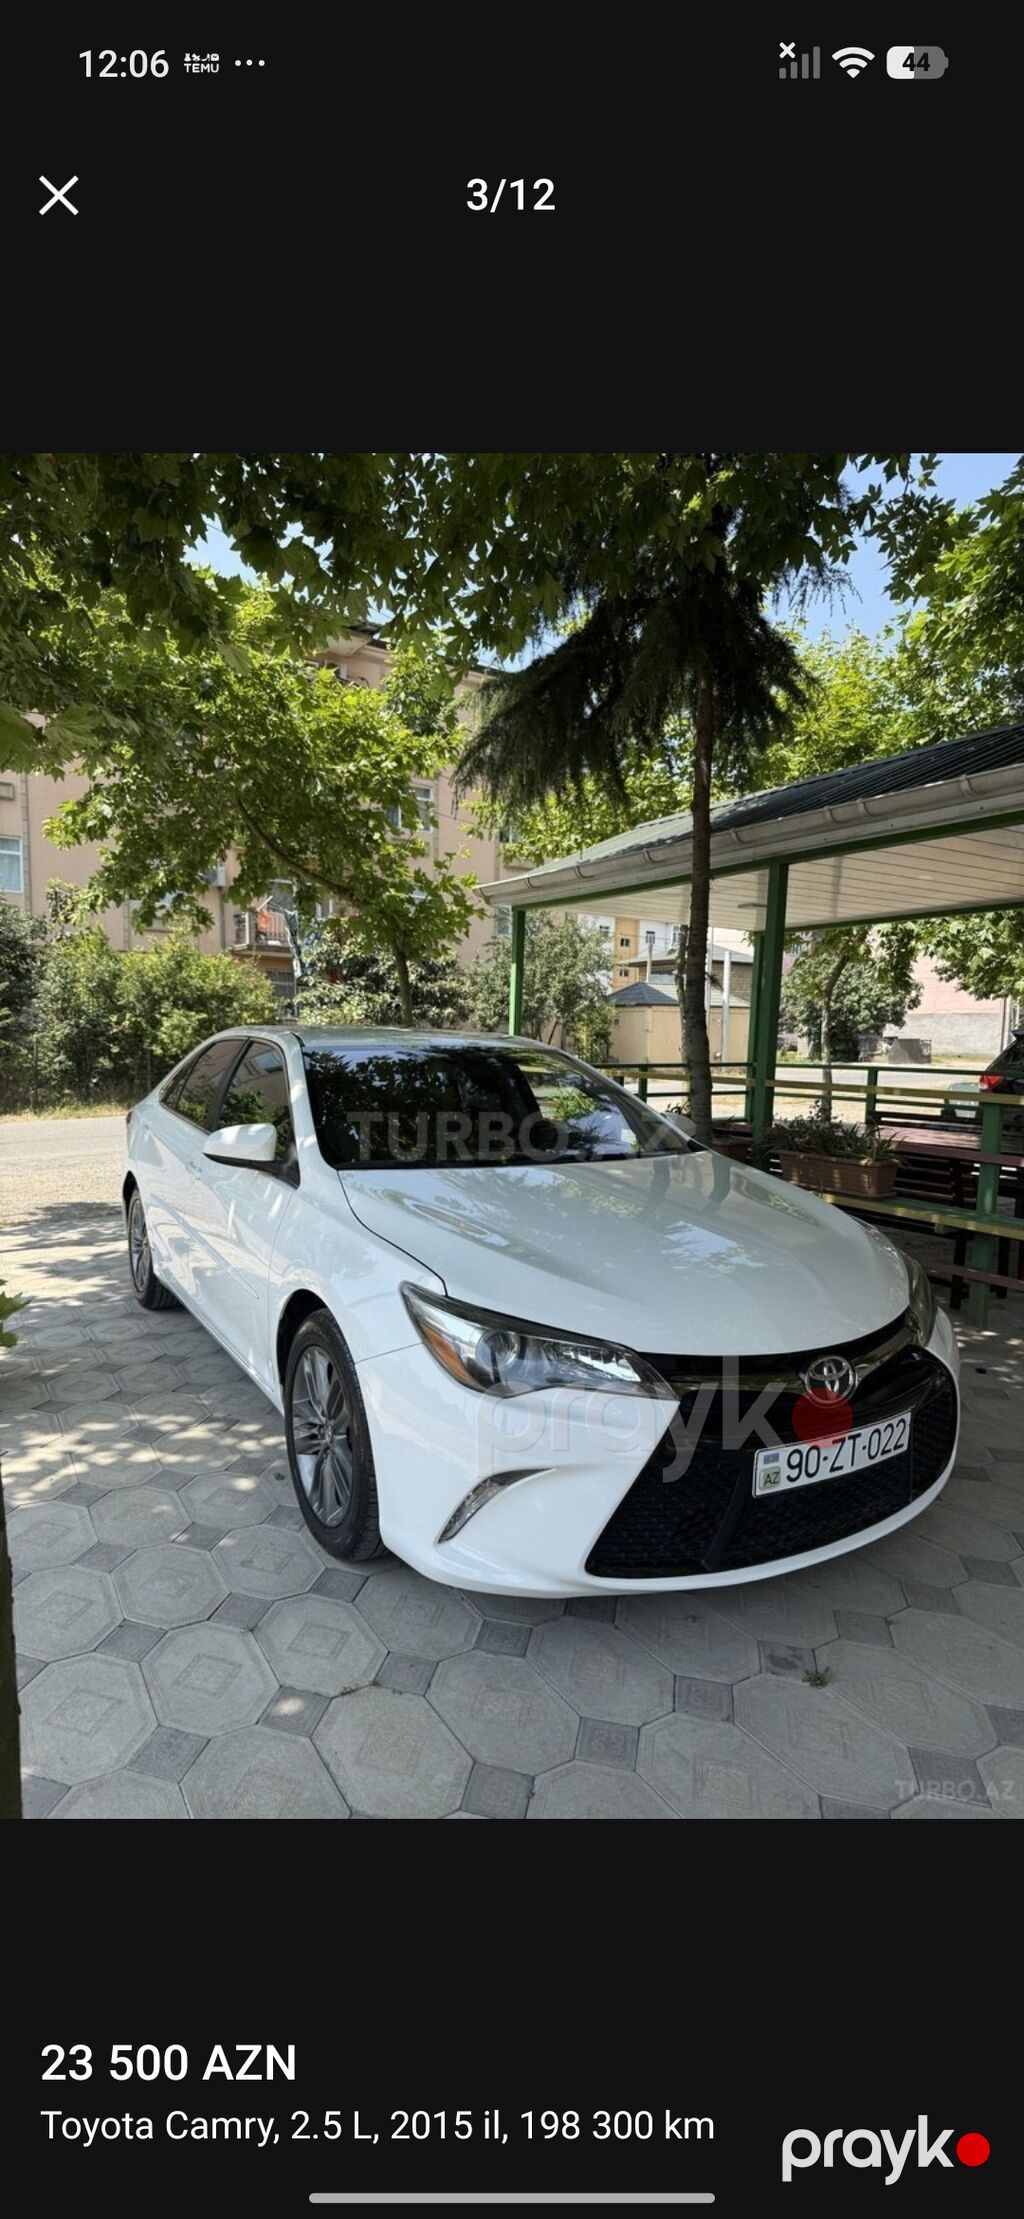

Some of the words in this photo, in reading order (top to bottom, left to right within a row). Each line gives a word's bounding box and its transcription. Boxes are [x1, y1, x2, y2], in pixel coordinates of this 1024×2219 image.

[79, 49, 170, 78] 12:06
[183, 62, 220, 74] TEMU
[902, 52, 931, 72] 44
[466, 177, 556, 214] 3/12
[763, 1470, 780, 1487] AZ
[41, 2043, 93, 2081] 23
[109, 2043, 189, 2081] 500
[201, 2044, 297, 2081] AZN
[40, 2110, 154, 2148] Toyota
[165, 2110, 280, 2148] Camry,
[290, 2110, 342, 2140] 2.5
[353, 2110, 379, 2145] L,
[390, 2110, 473, 2140] 2015
[484, 2109, 508, 2145] il,
[520, 2110, 581, 2140] 198
[592, 2110, 653, 2140] 300
[665, 2109, 714, 2140] km
